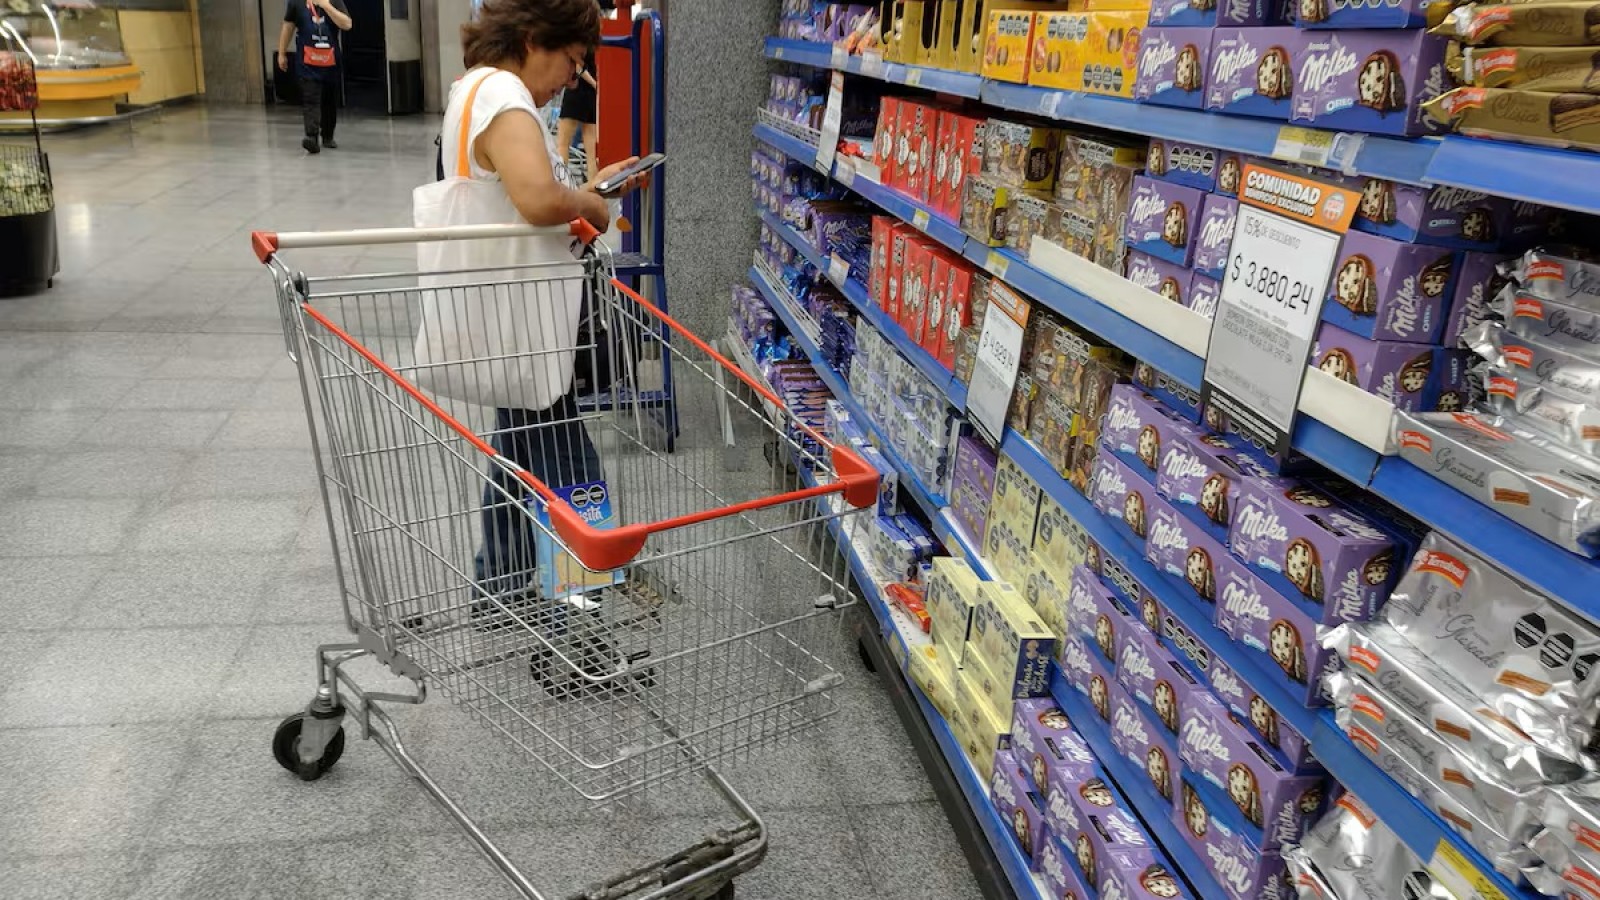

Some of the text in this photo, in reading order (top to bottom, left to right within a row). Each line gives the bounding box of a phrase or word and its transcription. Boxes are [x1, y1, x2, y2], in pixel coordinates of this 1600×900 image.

[1140, 43, 1176, 77] Milka
[1212, 42, 1258, 84] Milka
[1299, 48, 1358, 92] Milka
[1247, 171, 1321, 205] COMUNIDAD
[1130, 193, 1166, 224] Milka
[1129, 265, 1160, 289] Milka
[1231, 253, 1242, 284] $
[1245, 261, 1314, 316] 3.880,24
[1391, 275, 1415, 337] Milka
[1108, 404, 1141, 431] Milka
[1164, 448, 1208, 479] Milka
[1099, 467, 1127, 495] Milka
[1150, 517, 1189, 550] Milka
[1236, 503, 1288, 543] Milka
[1072, 584, 1098, 615] Milka
[1222, 581, 1271, 621] Milka
[1340, 568, 1363, 622] Milka
[1066, 643, 1093, 674] Milka
[1122, 644, 1156, 680] Milka
[1212, 667, 1244, 698] Milka
[1114, 706, 1149, 746] Milka
[1184, 717, 1231, 762] Milka
